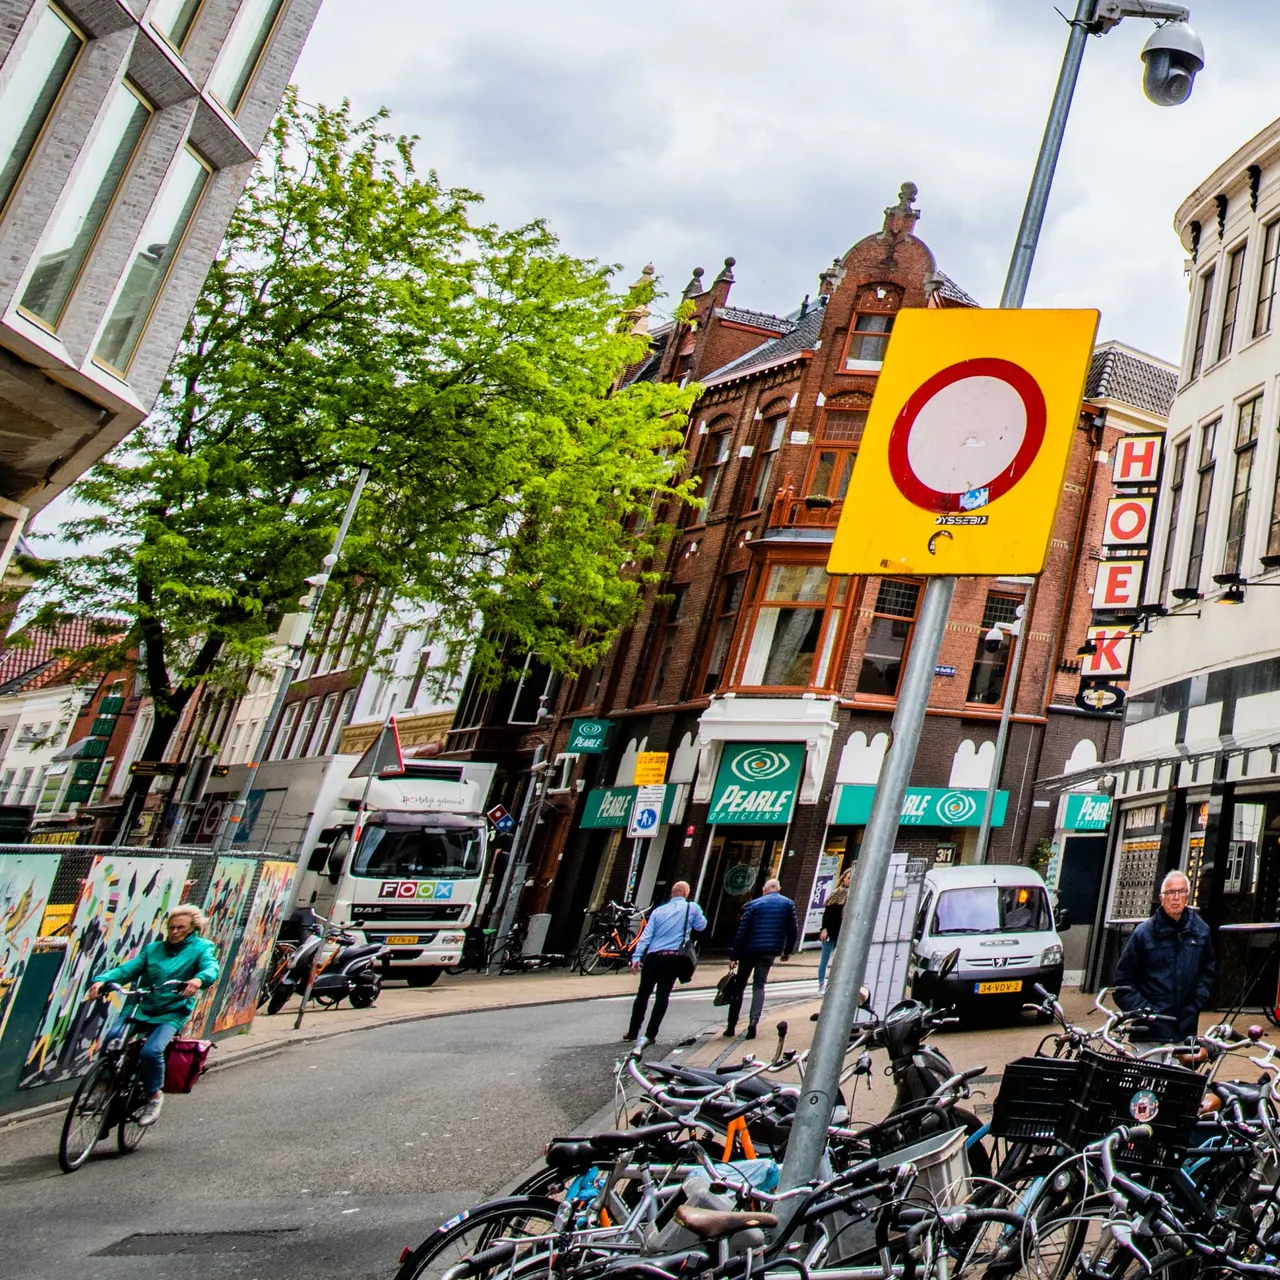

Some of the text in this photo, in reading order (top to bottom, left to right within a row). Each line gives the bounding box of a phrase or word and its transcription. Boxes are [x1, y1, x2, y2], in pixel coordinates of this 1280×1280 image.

[1089, 439, 1156, 672] HOEK
[573, 736, 603, 748] PEARLE
[596, 791, 632, 818] PEARLE
[713, 785, 793, 812] PEARLE
[900, 794, 932, 816] RLE
[709, 812, 780, 820] OPTICIENS
[382, 882, 453, 897] FOOX
[981, 982, 1019, 992] 34-VDV-2
